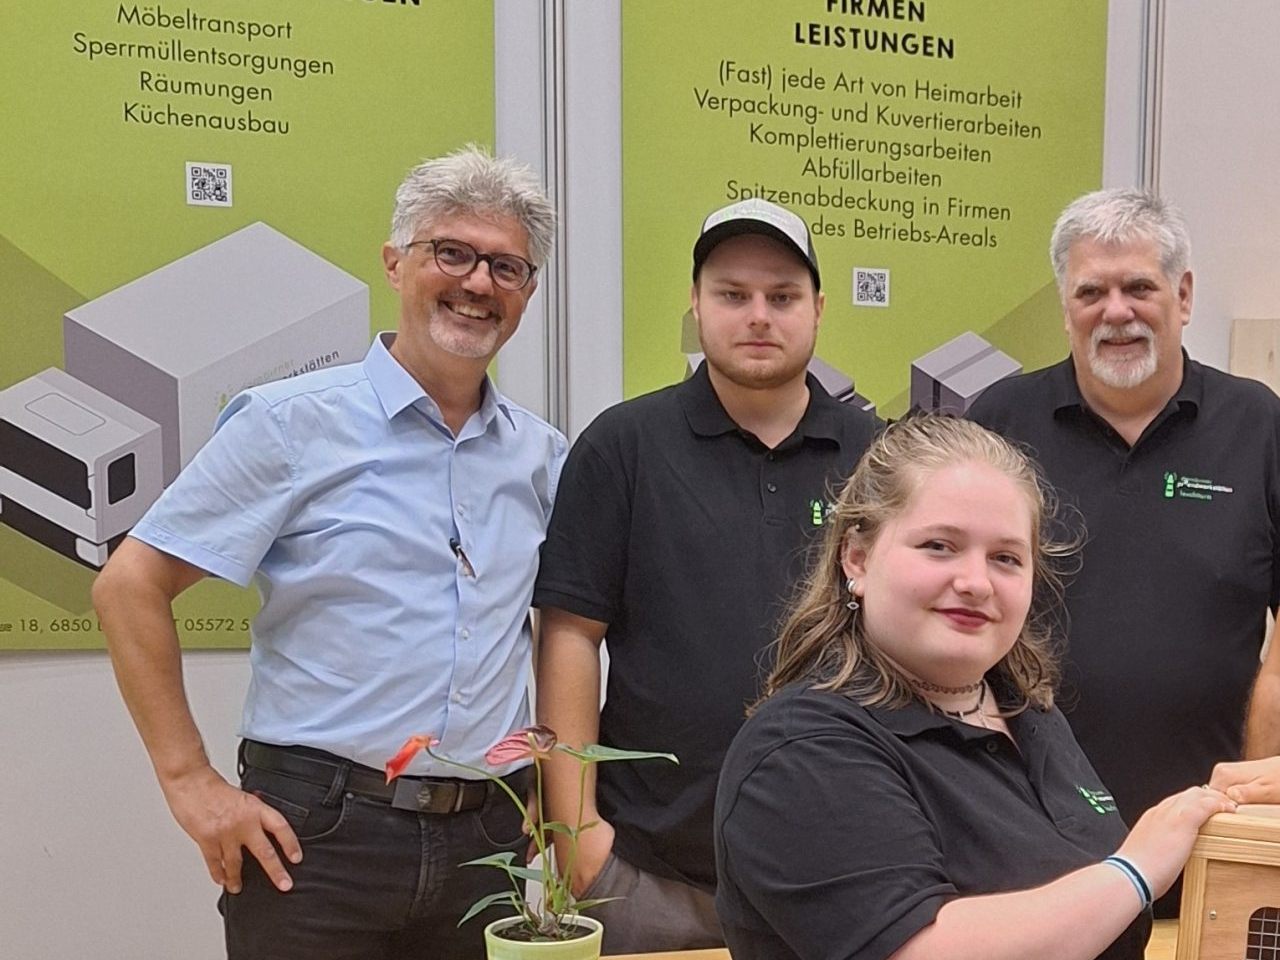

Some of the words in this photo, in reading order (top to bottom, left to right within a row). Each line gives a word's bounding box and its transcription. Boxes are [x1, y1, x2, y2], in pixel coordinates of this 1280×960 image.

[117, 3, 292, 42] Möbeltransport
[826, 0, 925, 22] FIRMEN
[73, 32, 334, 78] Sperrmüllentsorgungen
[795, 22, 954, 59] LEISTUNGEN
[140, 71, 272, 105] Räumungen
[719, 59, 772, 91] (Fast)
[782, 67, 826, 93] jede
[833, 72, 864, 94] Art
[871, 81, 906, 98] von
[915, 79, 1022, 109] Heimarbeit
[124, 102, 290, 134] Küchenausbau
[694, 87, 824, 125] Verpackung-
[831, 102, 868, 123] und
[877, 104, 1042, 139] Kuvertierarbeiten
[750, 123, 991, 163] Komplettierungsarbeiten
[801, 157, 942, 187] Abfüllarbeiten
[726, 180, 914, 219] Spitzenabdeckung
[923, 196, 939, 215] in
[948, 198, 1011, 220] Firmen
[811, 215, 846, 238] des
[854, 218, 997, 247] Betriebs-Areals
[20, 618, 43, 634] 18,
[50, 618, 92, 632] 6850
[184, 618, 234, 631] 05572
